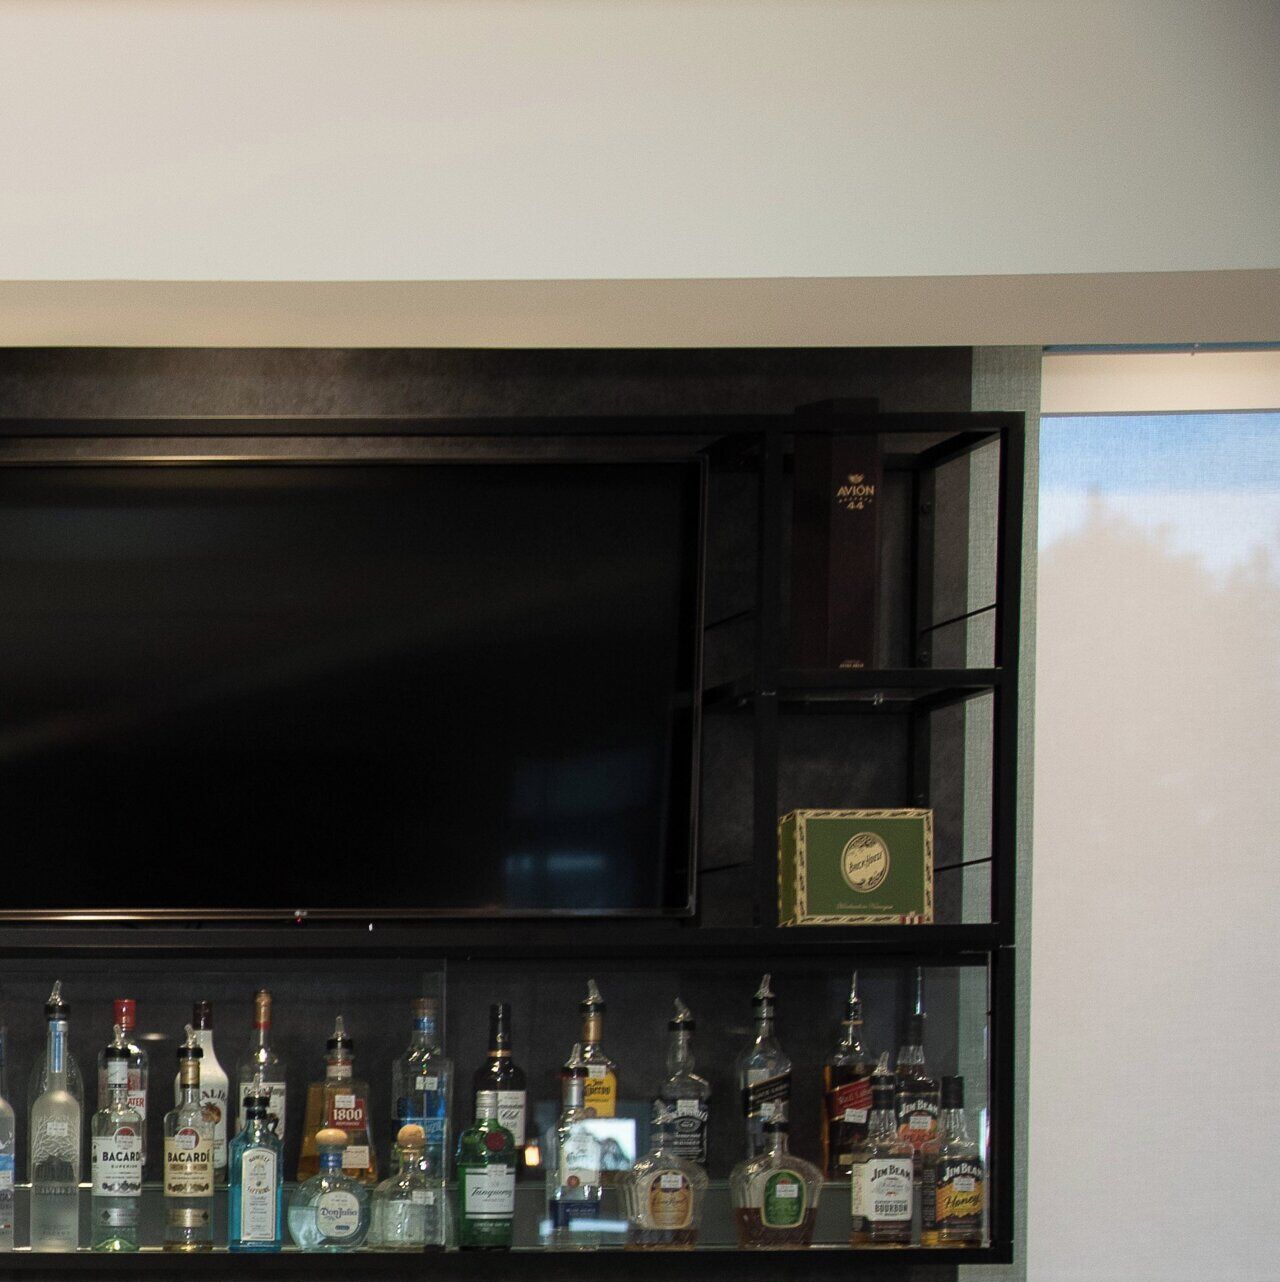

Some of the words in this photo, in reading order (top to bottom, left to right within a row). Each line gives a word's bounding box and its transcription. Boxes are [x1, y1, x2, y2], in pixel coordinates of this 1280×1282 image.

[201, 1088, 227, 1100] ALIB
[332, 1108, 363, 1121] 1800
[102, 1151, 141, 1162] BACARD
[167, 1149, 210, 1163] BACARDÍ
[871, 1167, 889, 1182] JIM
[890, 1165, 912, 1180] BEAM
[942, 1165, 961, 1181] JIM
[944, 1193, 982, 1210] Honey
